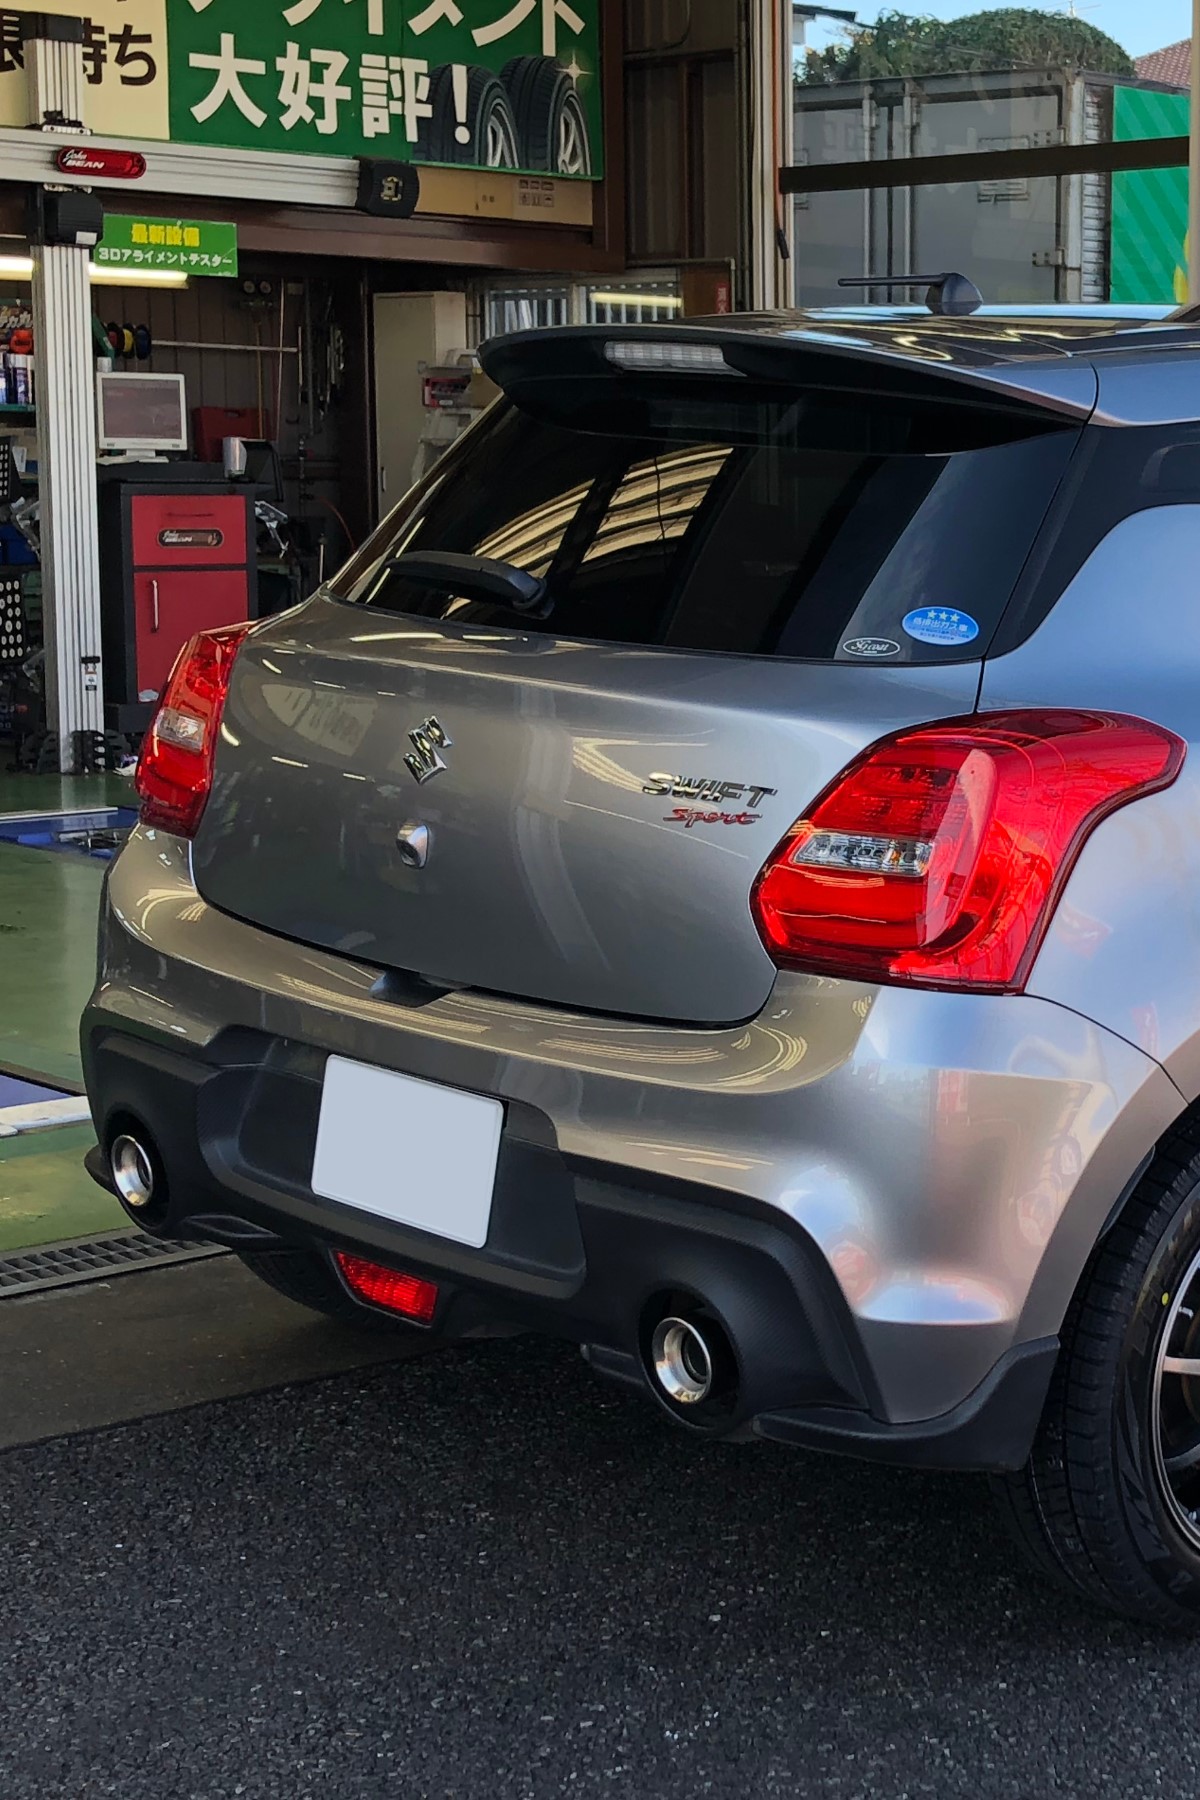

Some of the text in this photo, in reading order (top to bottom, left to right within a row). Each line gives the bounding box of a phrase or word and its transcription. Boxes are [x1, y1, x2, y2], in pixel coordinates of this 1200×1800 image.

[188, 33, 471, 145] 大好評！
[131, 222, 200, 247] 最新設備
[98, 247, 232, 268] 3Dアライメントテスター
[642, 772, 778, 809] SWIFT
[662, 806, 762, 828] Sport
